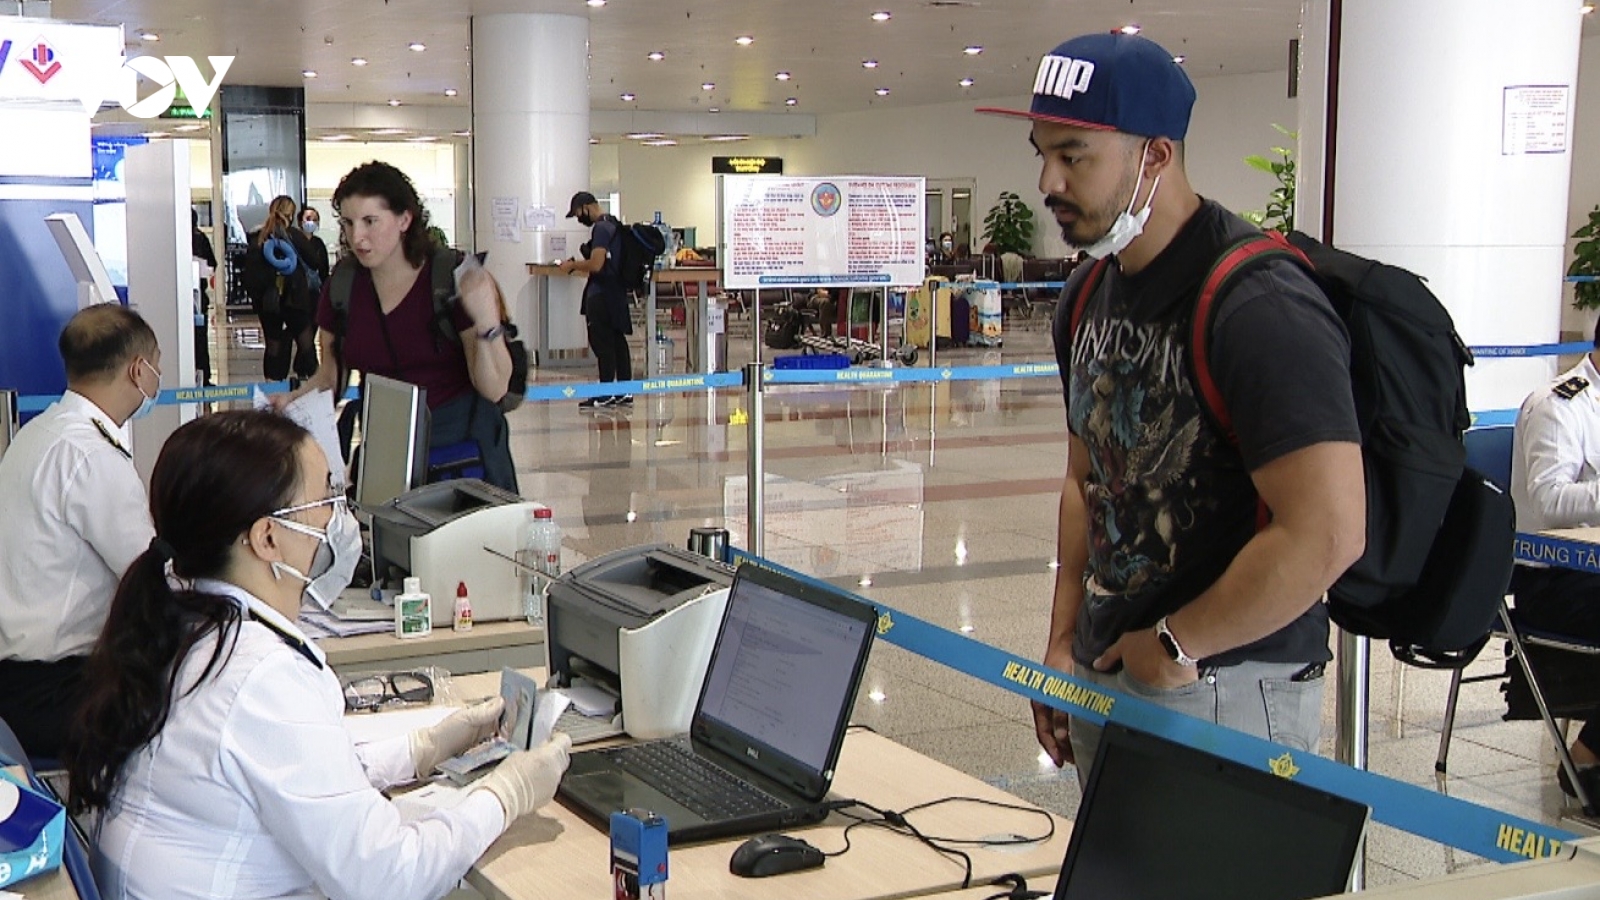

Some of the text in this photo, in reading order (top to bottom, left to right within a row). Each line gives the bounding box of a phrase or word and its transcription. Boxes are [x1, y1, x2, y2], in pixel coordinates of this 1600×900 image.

[837, 369, 893, 380] HEALTH QUARANTINE
[642, 376, 704, 390] HEALTH QUARANTINE
[176, 387, 248, 400] HEALTH QUARANTINE
[1513, 539, 1600, 569] TRUNG TÂ
[1002, 661, 1116, 717] HEALTH QUARANTINE
